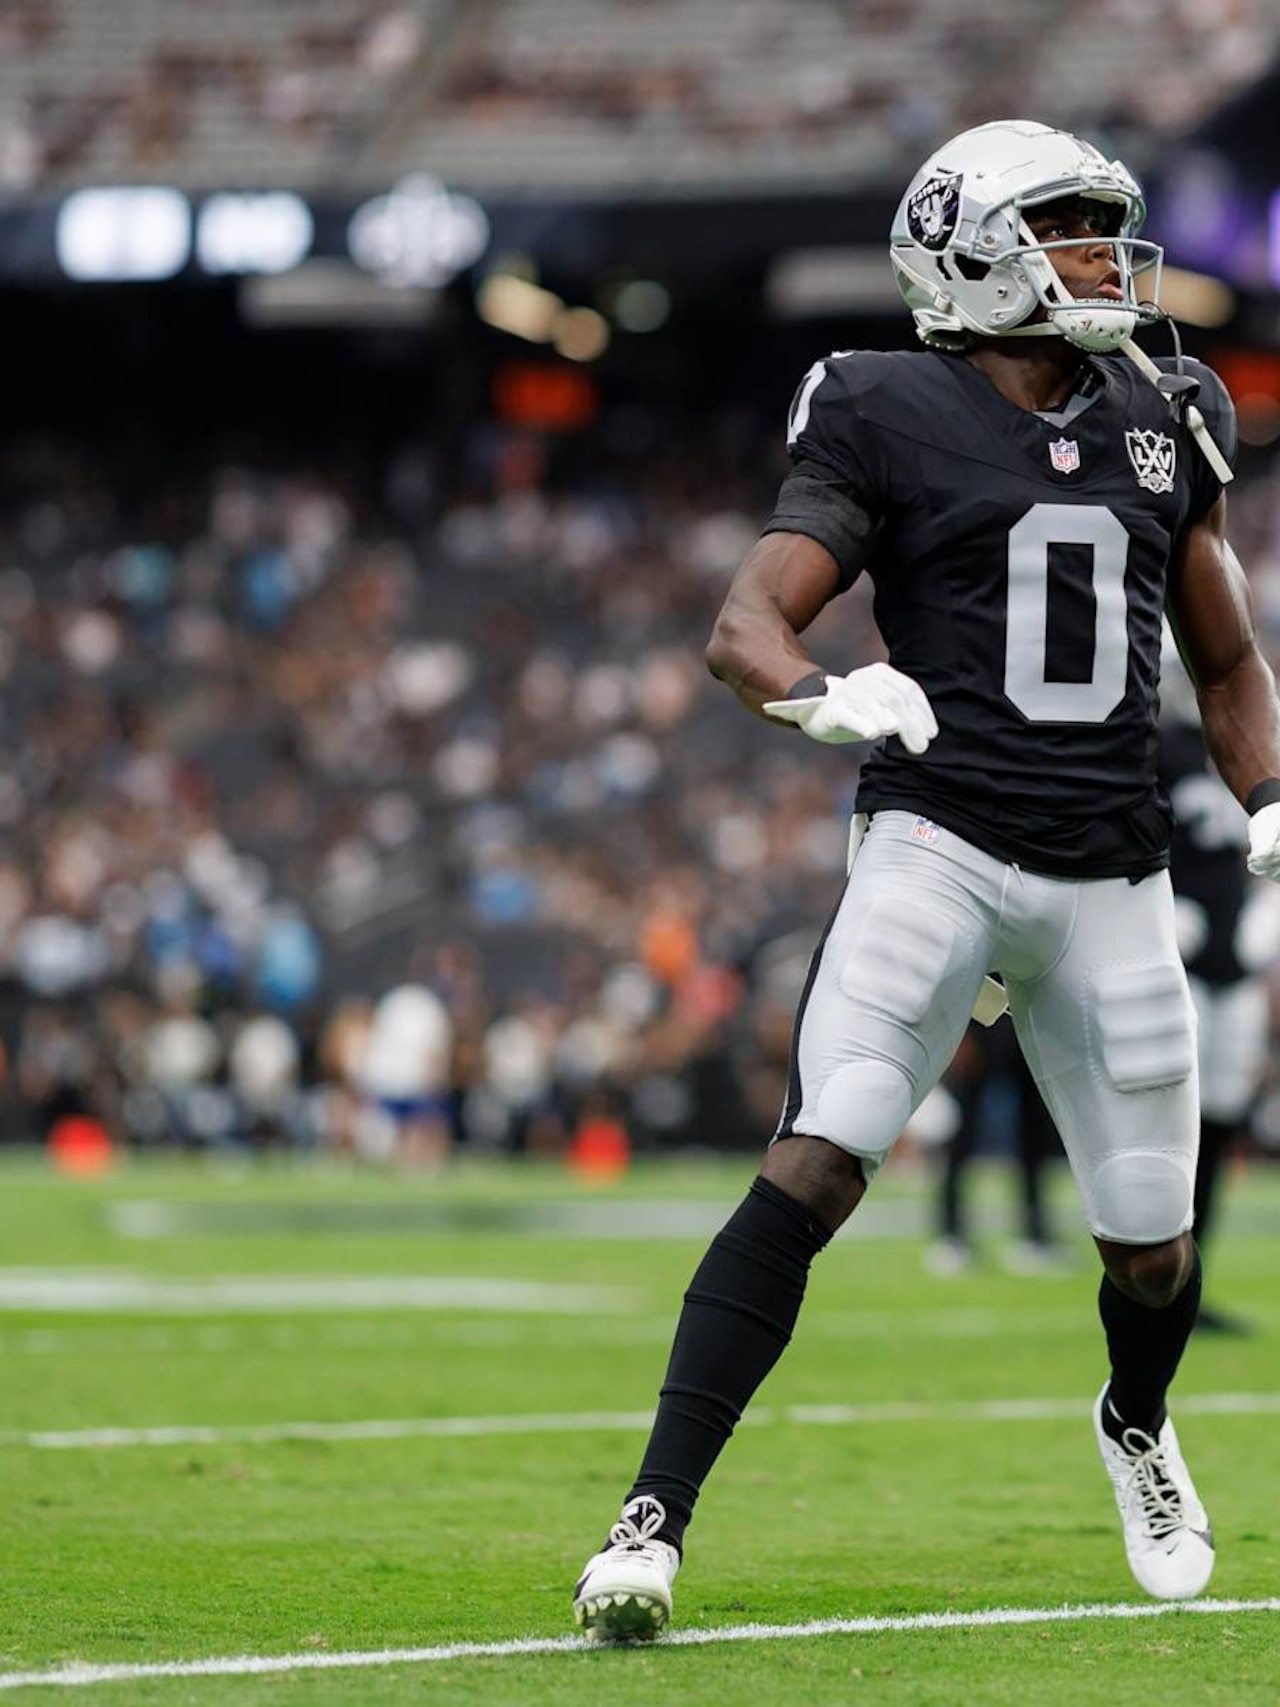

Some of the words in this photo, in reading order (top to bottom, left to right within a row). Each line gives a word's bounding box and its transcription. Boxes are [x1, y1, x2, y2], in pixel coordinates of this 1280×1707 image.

[1055, 453, 1077, 467] NFL
[1133, 445, 1172, 471] LXV
[1004, 503, 1130, 724] 0
[915, 826, 934, 840] NFL
